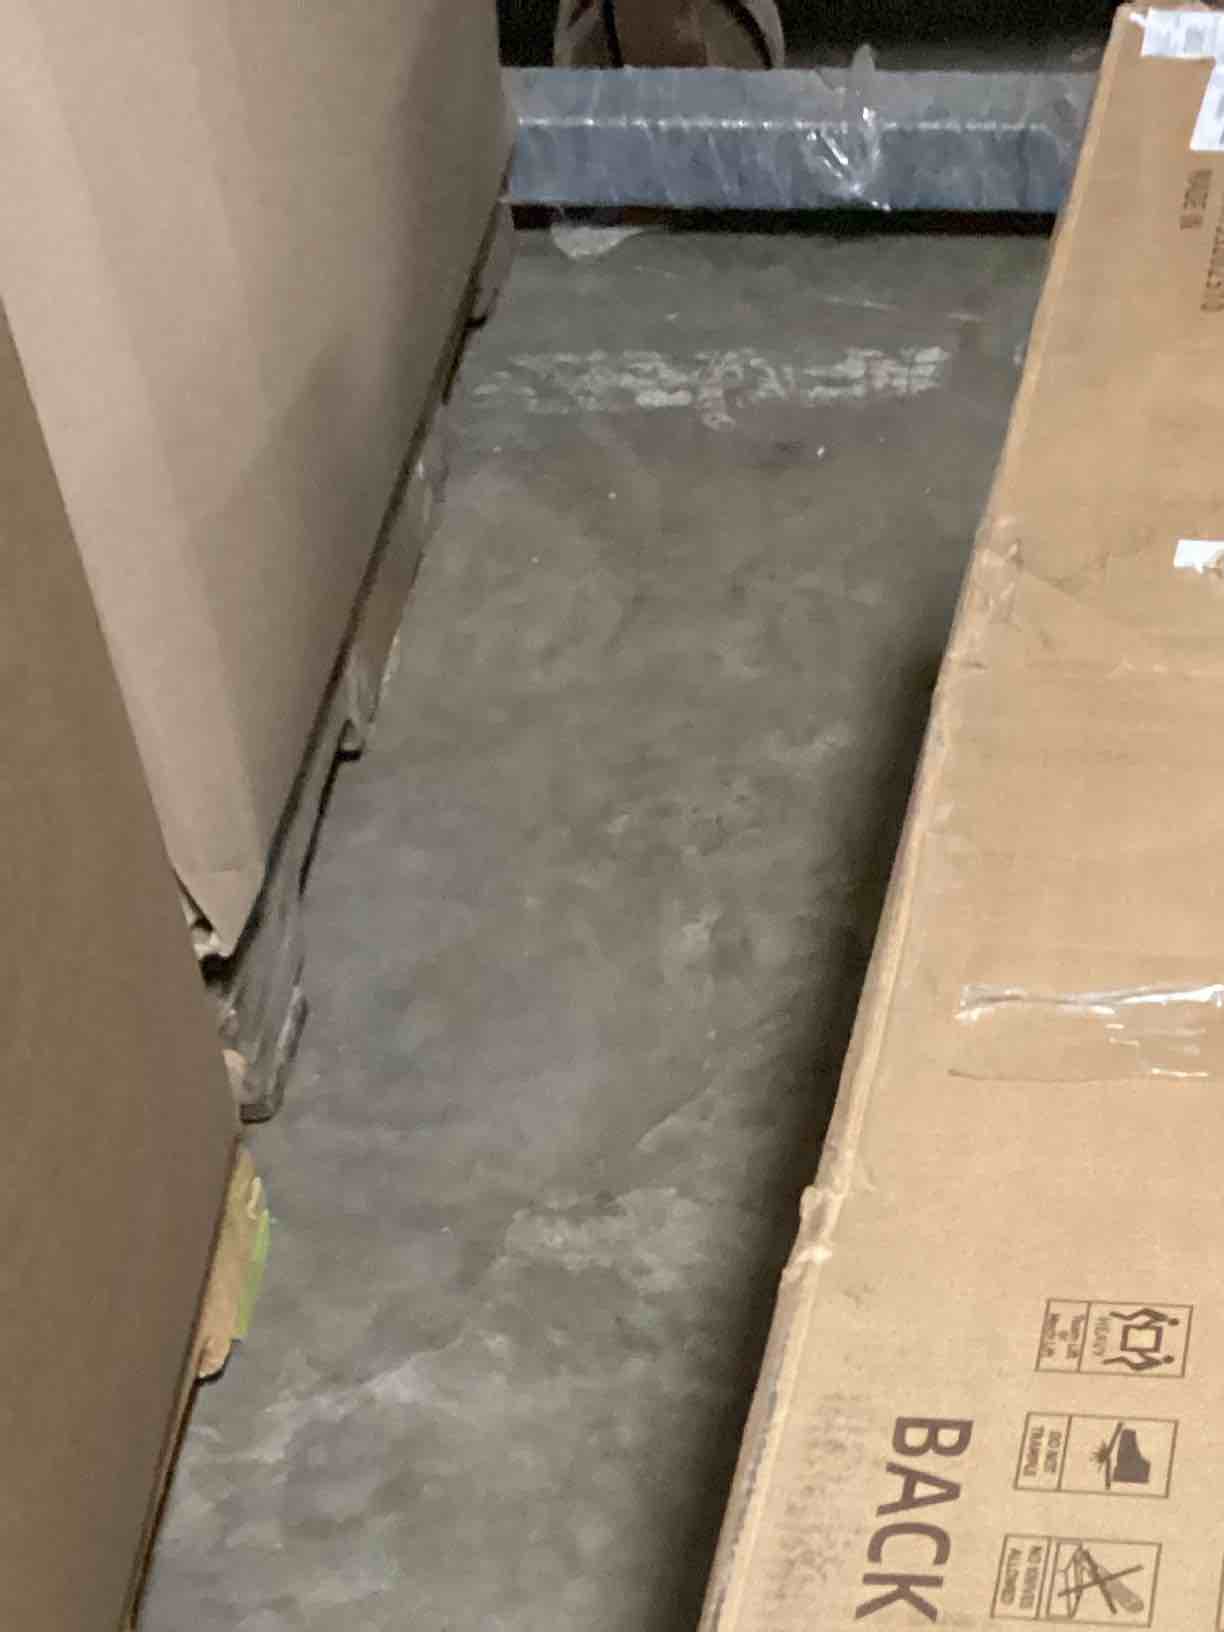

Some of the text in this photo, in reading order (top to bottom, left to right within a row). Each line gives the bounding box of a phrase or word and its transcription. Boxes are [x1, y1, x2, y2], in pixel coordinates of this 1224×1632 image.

[854, 1416, 974, 1623] BACK
[1000, 1546, 1022, 1605] ALLOWED
[1026, 1544, 1043, 1564] NO
